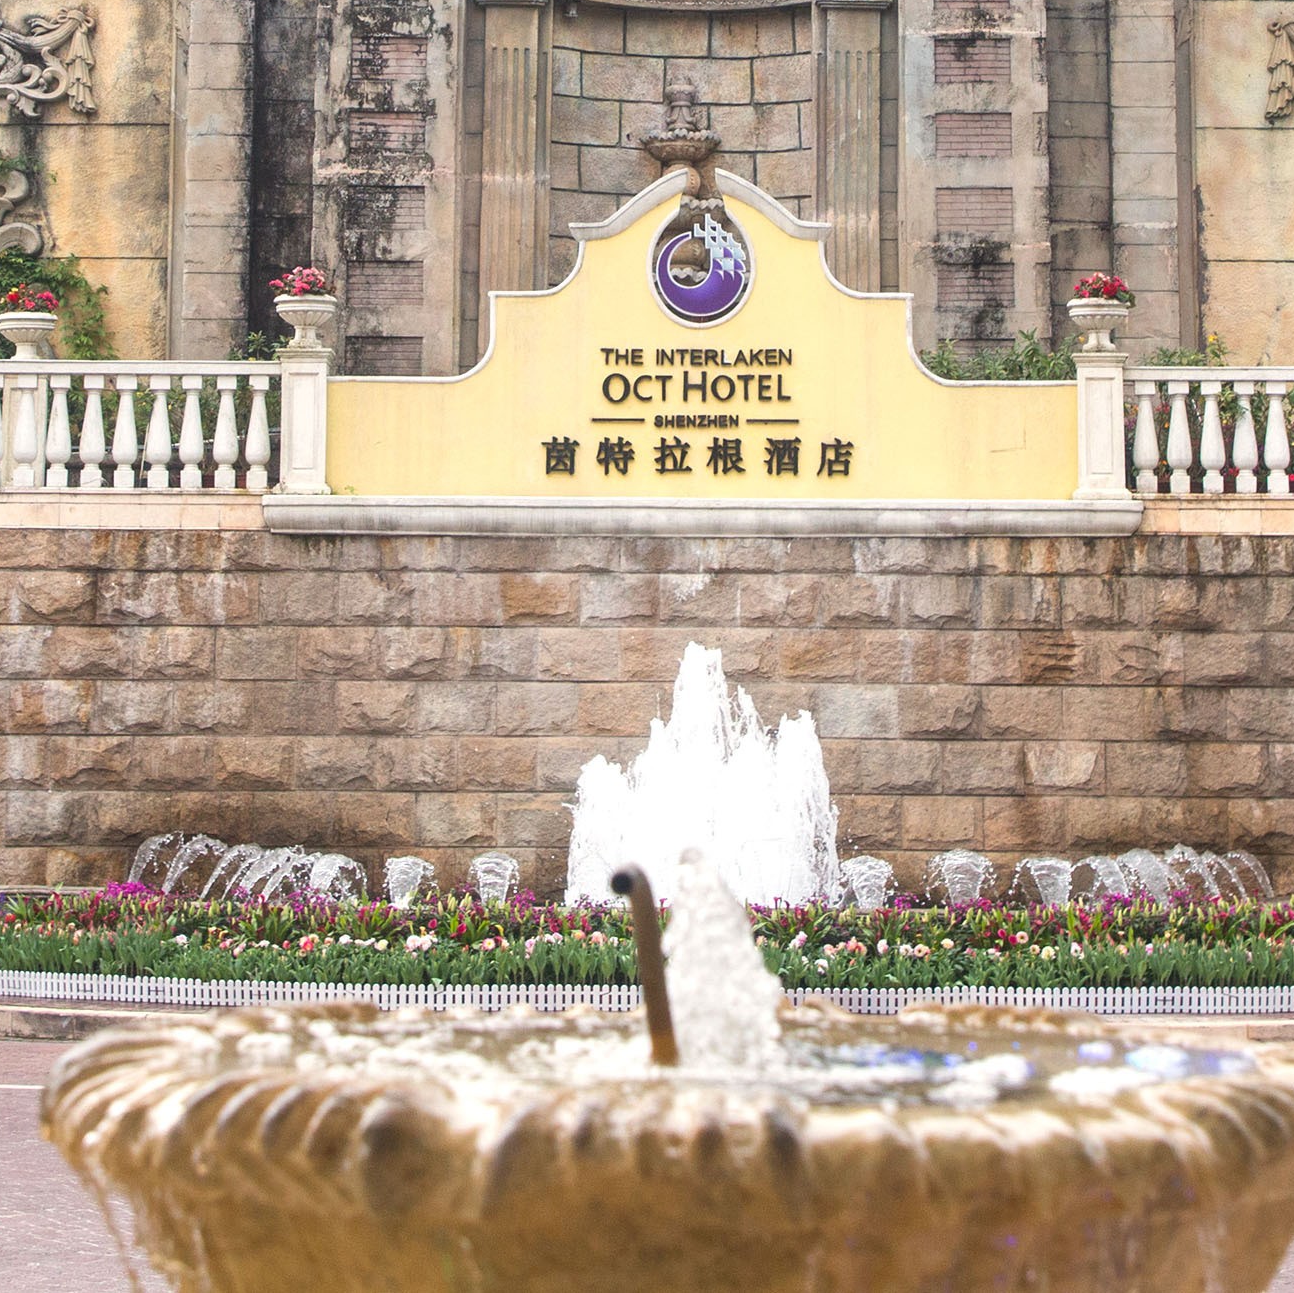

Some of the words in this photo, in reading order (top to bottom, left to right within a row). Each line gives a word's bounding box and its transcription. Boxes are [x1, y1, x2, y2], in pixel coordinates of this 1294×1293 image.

[600, 348, 644, 366] THE
[656, 348, 793, 367] INTERLAKEN
[602, 373, 673, 403] OCT
[682, 371, 792, 403] HOTEL
[654, 414, 740, 428] SHENZHEN
[541, 436, 854, 478] 茵特拉根酒店
